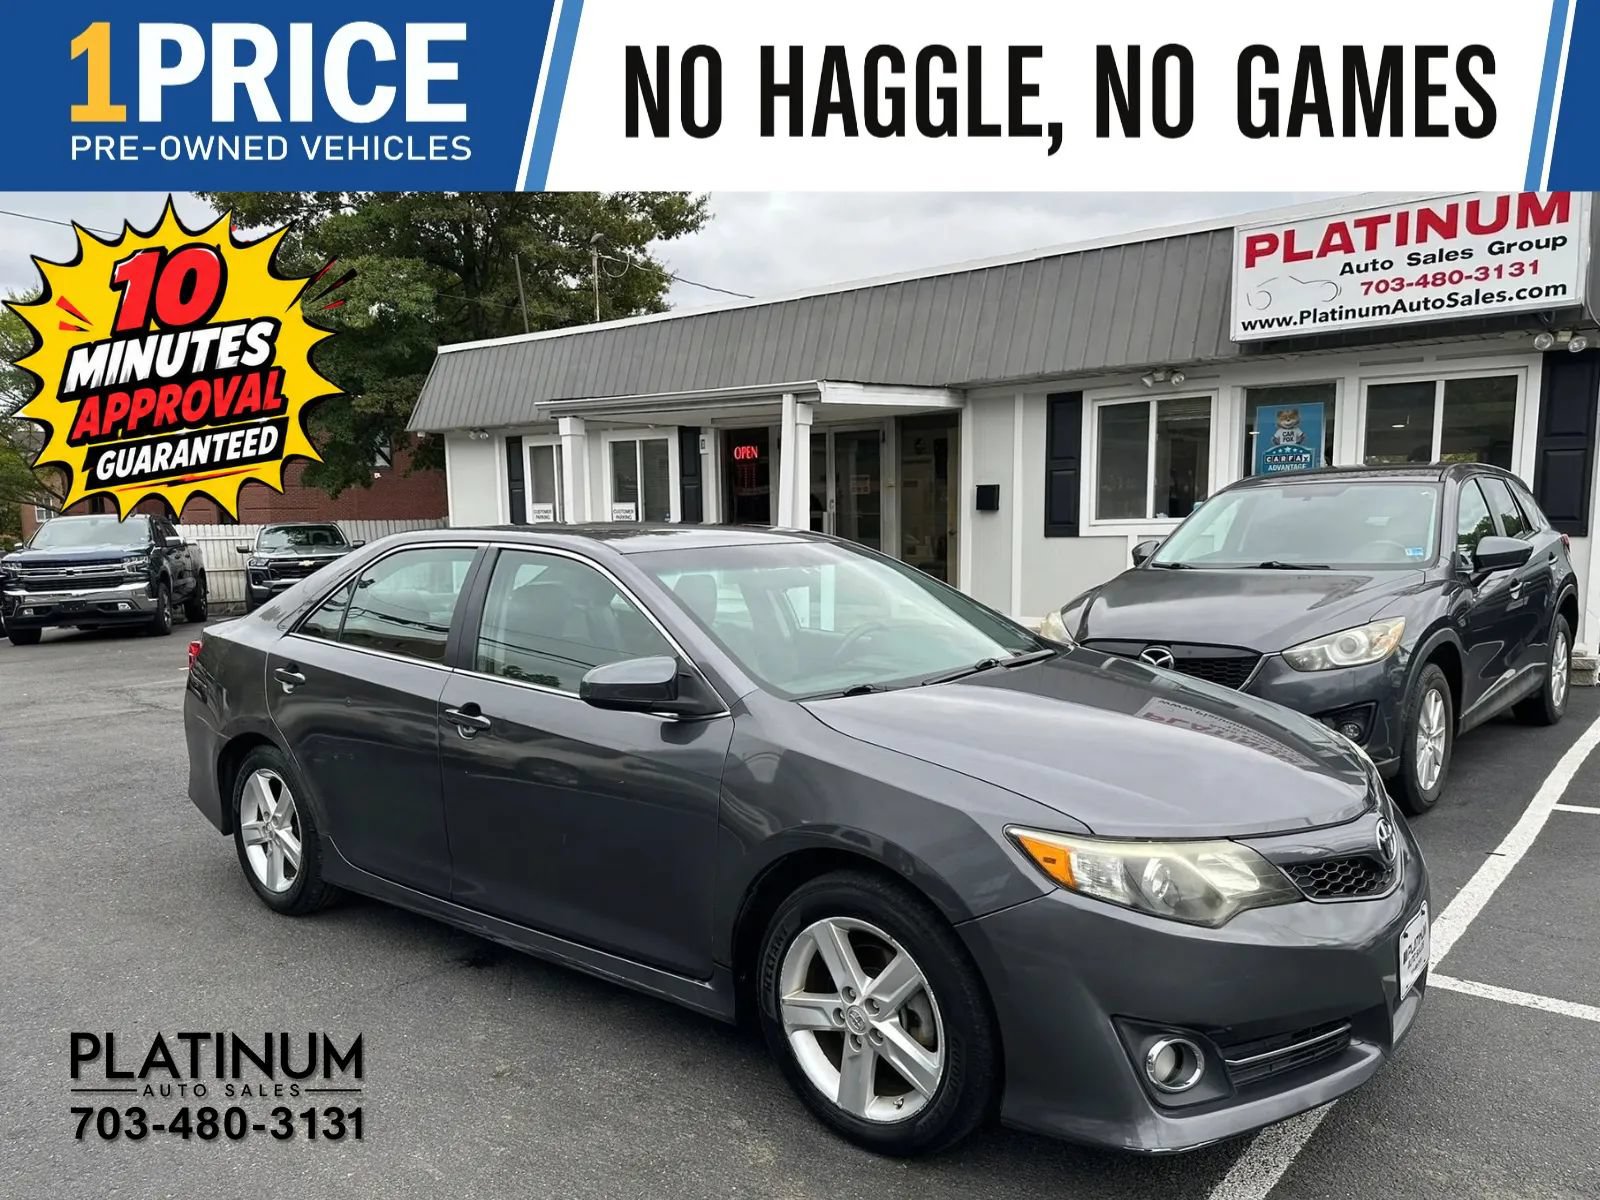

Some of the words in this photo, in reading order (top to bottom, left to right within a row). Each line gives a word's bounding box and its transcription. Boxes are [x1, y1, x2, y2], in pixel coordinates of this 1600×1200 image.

[1245, 192, 1572, 268] PLATINUM
[1339, 258, 1394, 276] Auto
[1406, 246, 1474, 266] Sales
[1487, 235, 1568, 256] Group
[1360, 259, 1540, 296] 703-480-3131
[1241, 283, 1568, 331] www.PlatinumAutoSales.com
[734, 445, 758, 459] OPEN
[1266, 454, 1310, 463] CARFAX
[1268, 463, 1307, 472] ADVANTAGE
